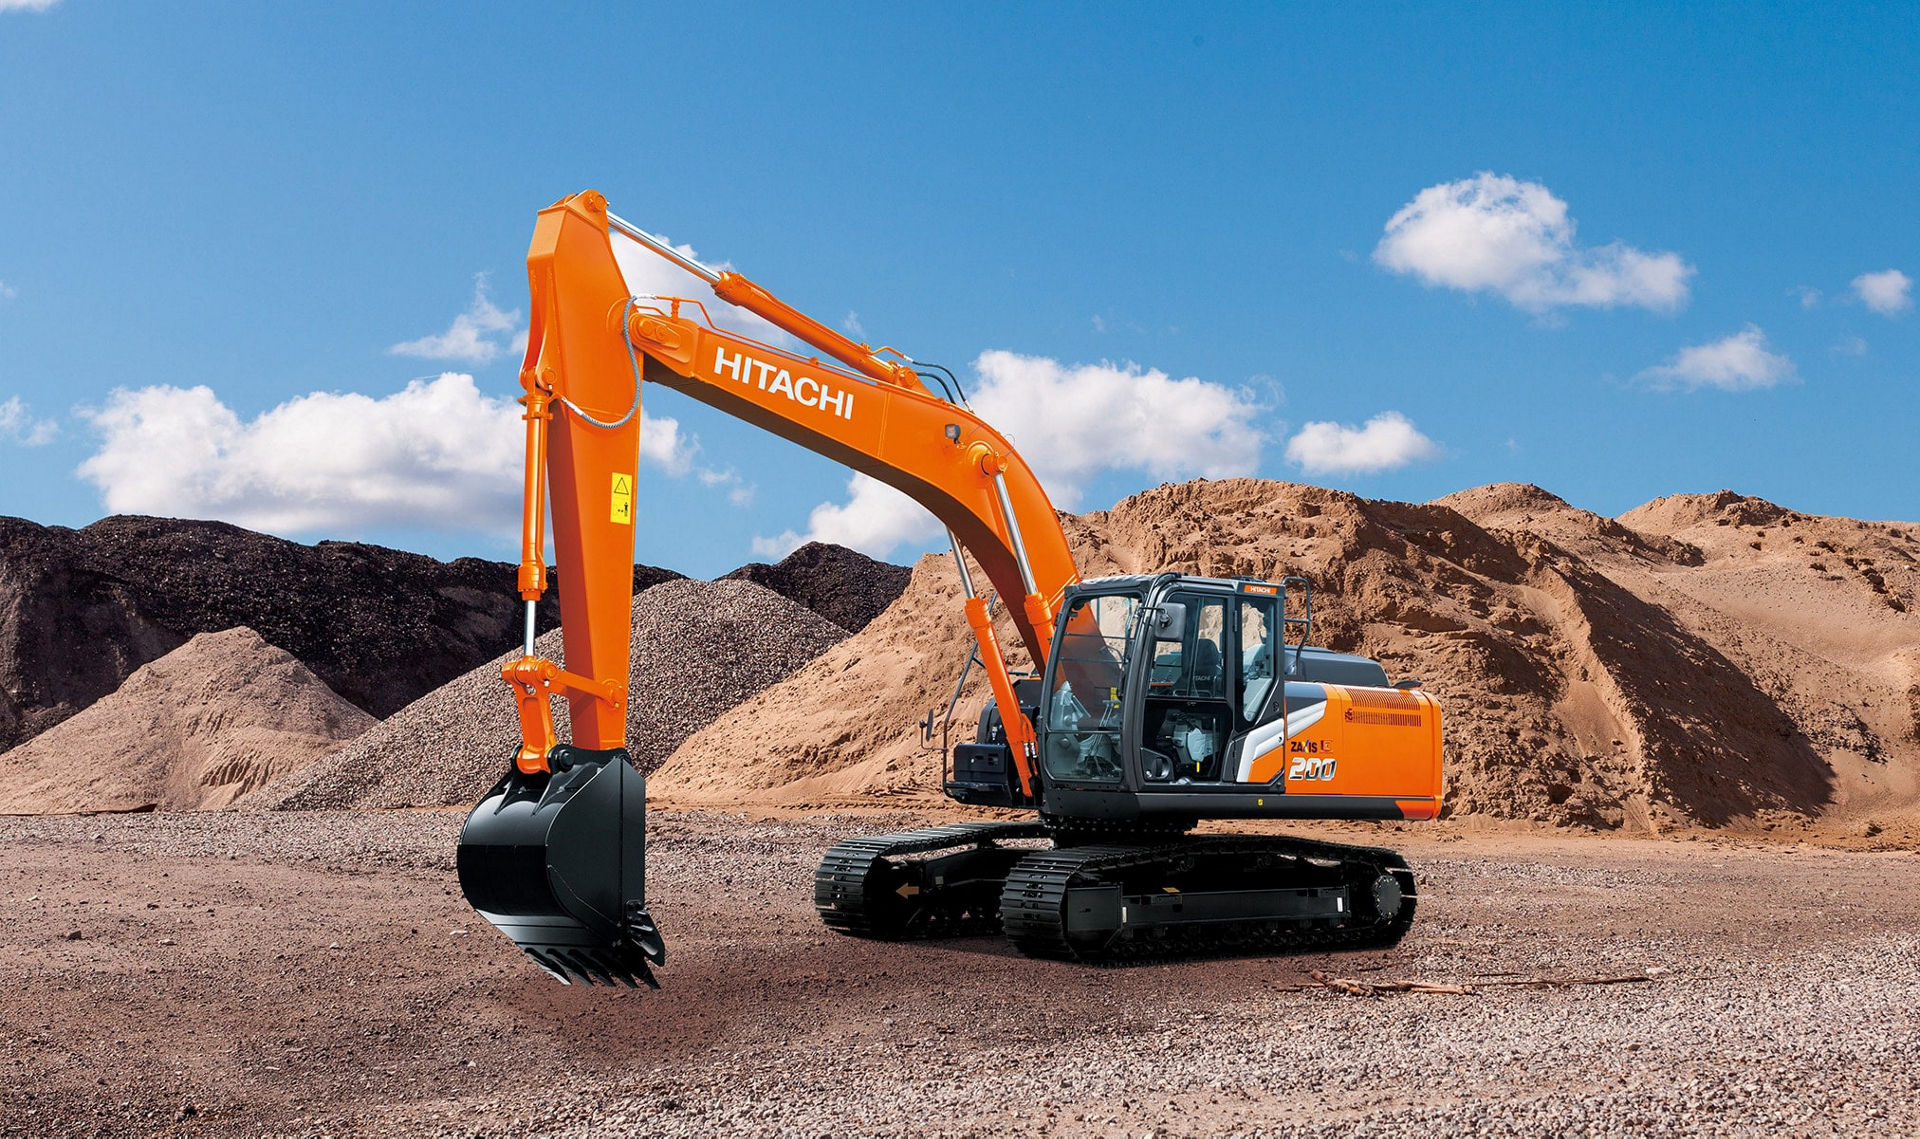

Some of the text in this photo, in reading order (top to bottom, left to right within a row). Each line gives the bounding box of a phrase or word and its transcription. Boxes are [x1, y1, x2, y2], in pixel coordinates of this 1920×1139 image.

[713, 345, 854, 420] HITACHI
[1290, 740, 1317, 753] ZAXIS
[1288, 757, 1337, 781] 200
